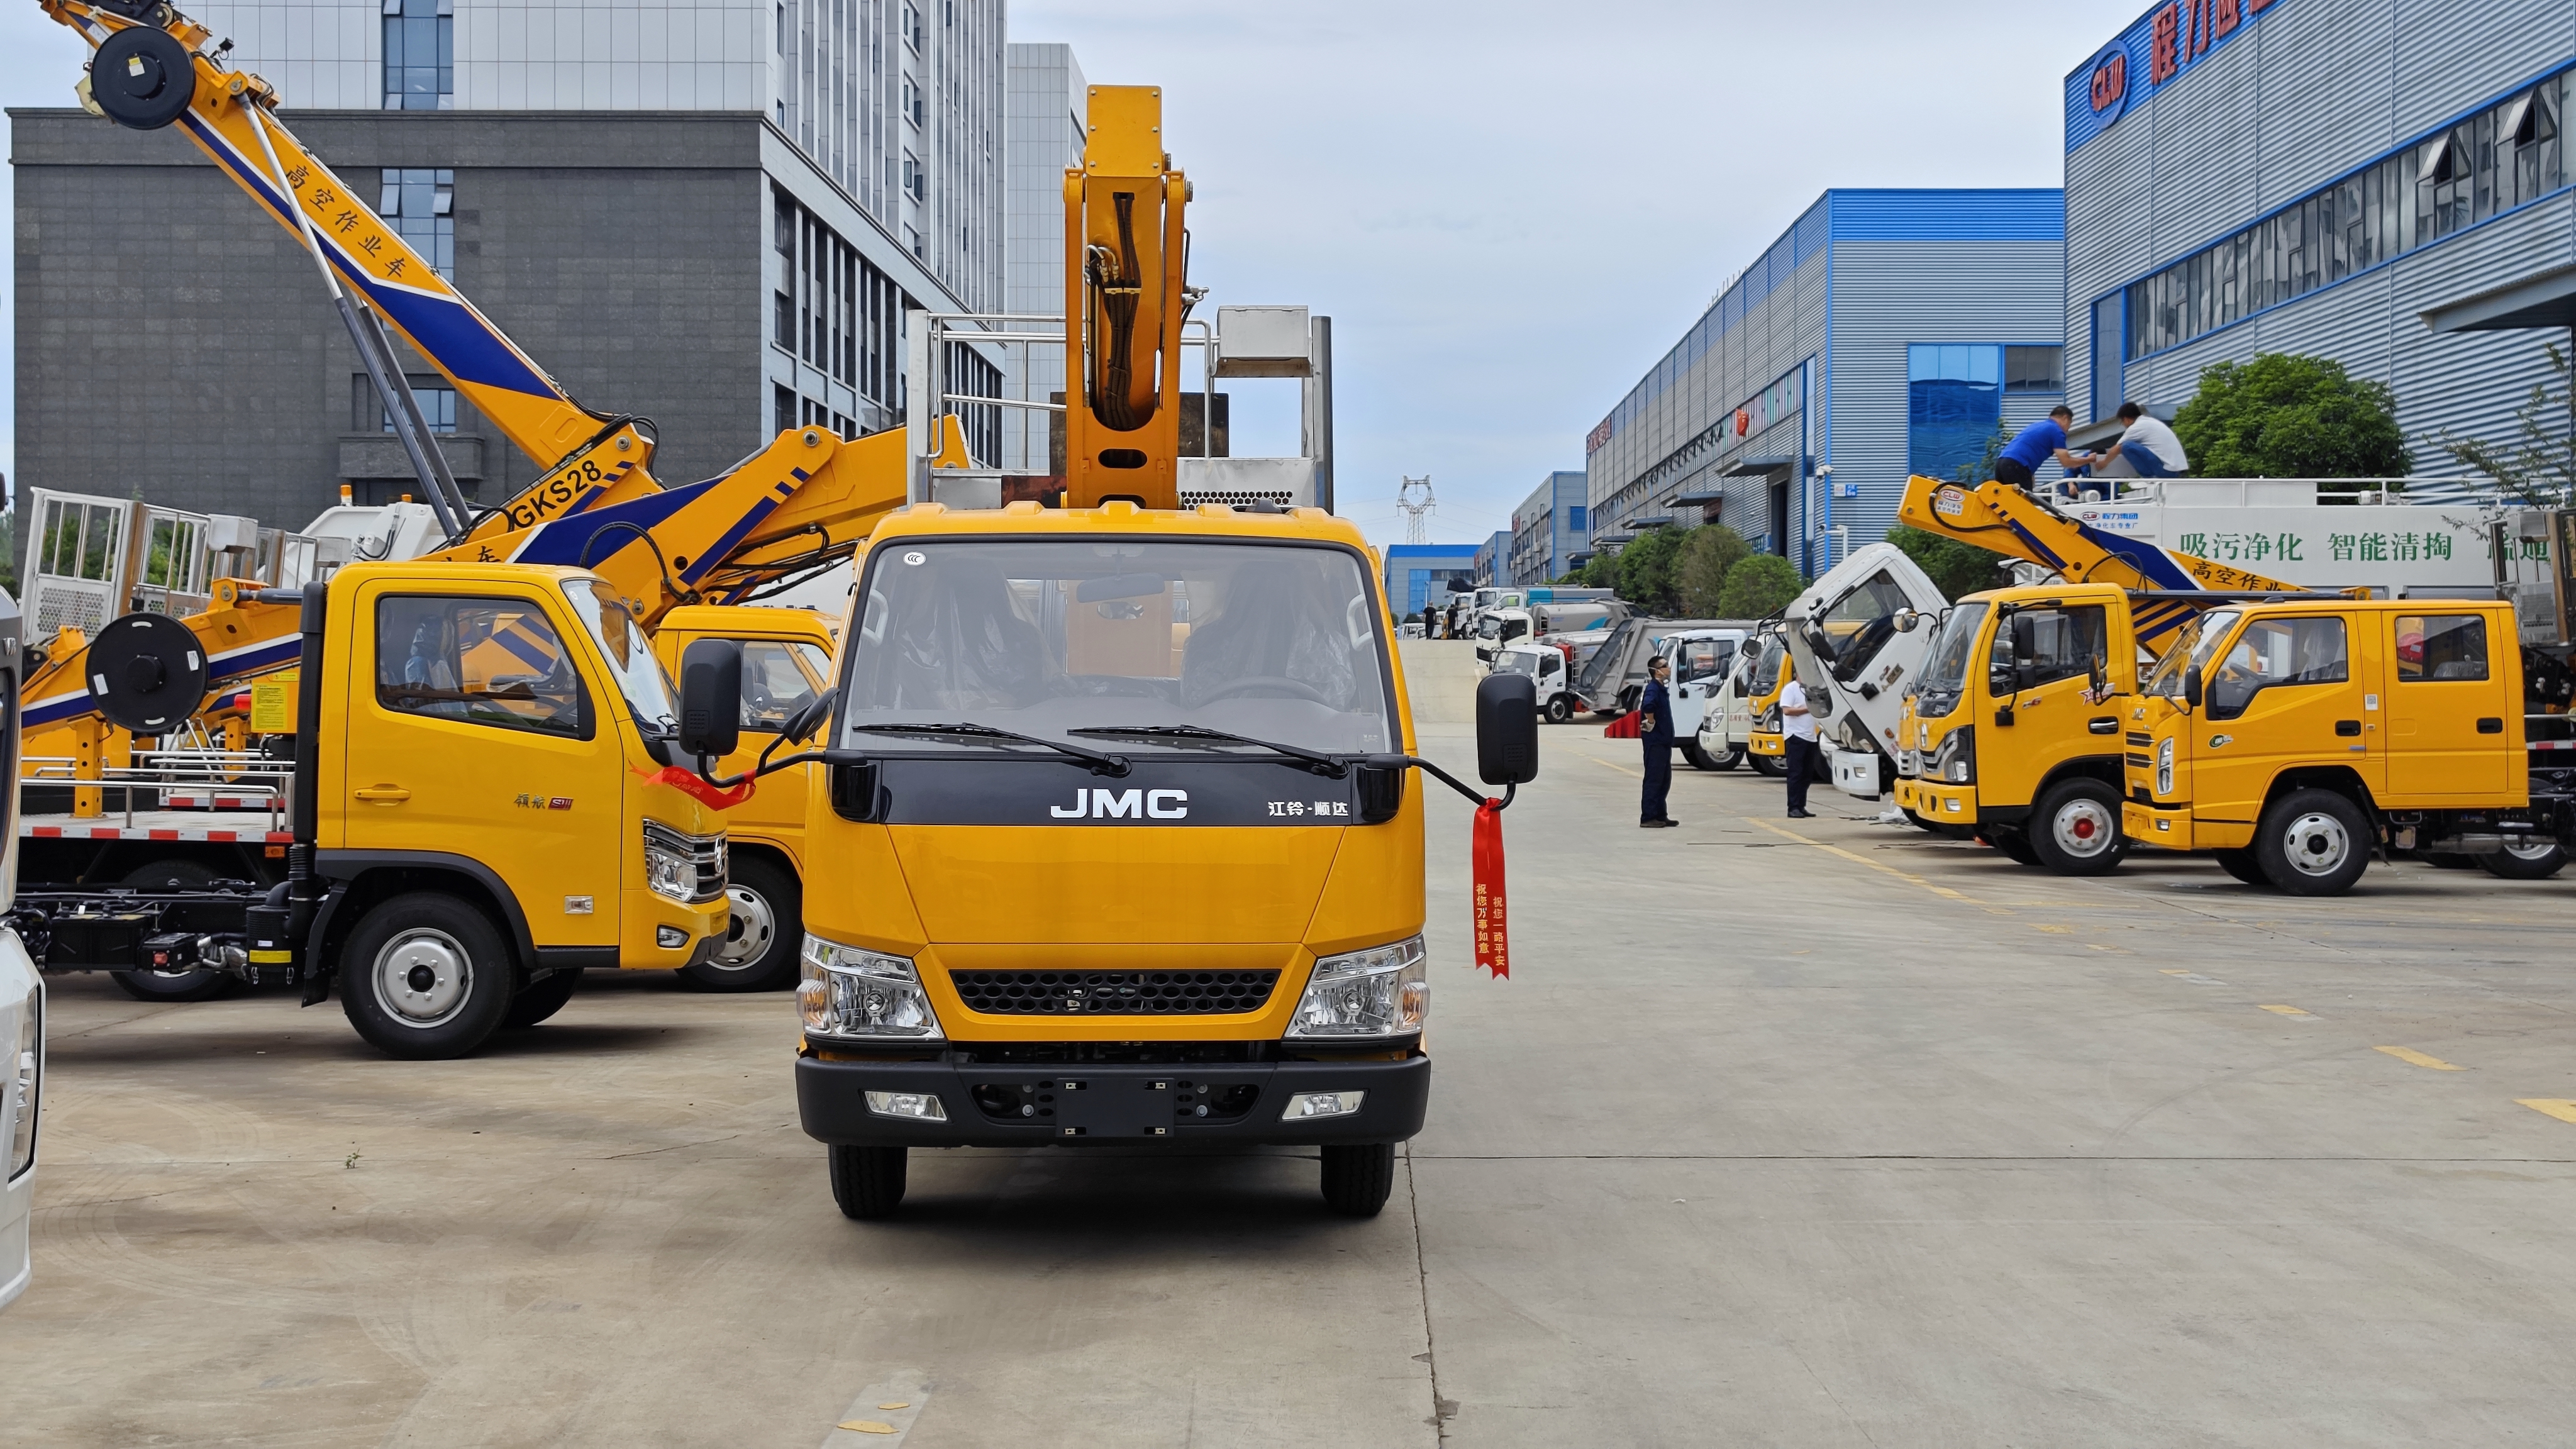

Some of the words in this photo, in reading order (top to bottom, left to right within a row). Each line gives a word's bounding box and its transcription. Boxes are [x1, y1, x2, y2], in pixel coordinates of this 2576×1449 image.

[2091, 55, 2124, 111] CLW
[286, 164, 406, 278] 高空作业车
[512, 460, 602, 529] GKS28
[1943, 491, 1960, 499] CLW
[2180, 532, 2304, 561] 吸污净化
[2327, 532, 2451, 561] 智能清掏
[2192, 561, 2301, 591] 高空作业
[1050, 788, 1188, 819] JMC
[1475, 884, 1489, 953] 祝您万事如意
[1493, 896, 1505, 966] 祝您一路平安
